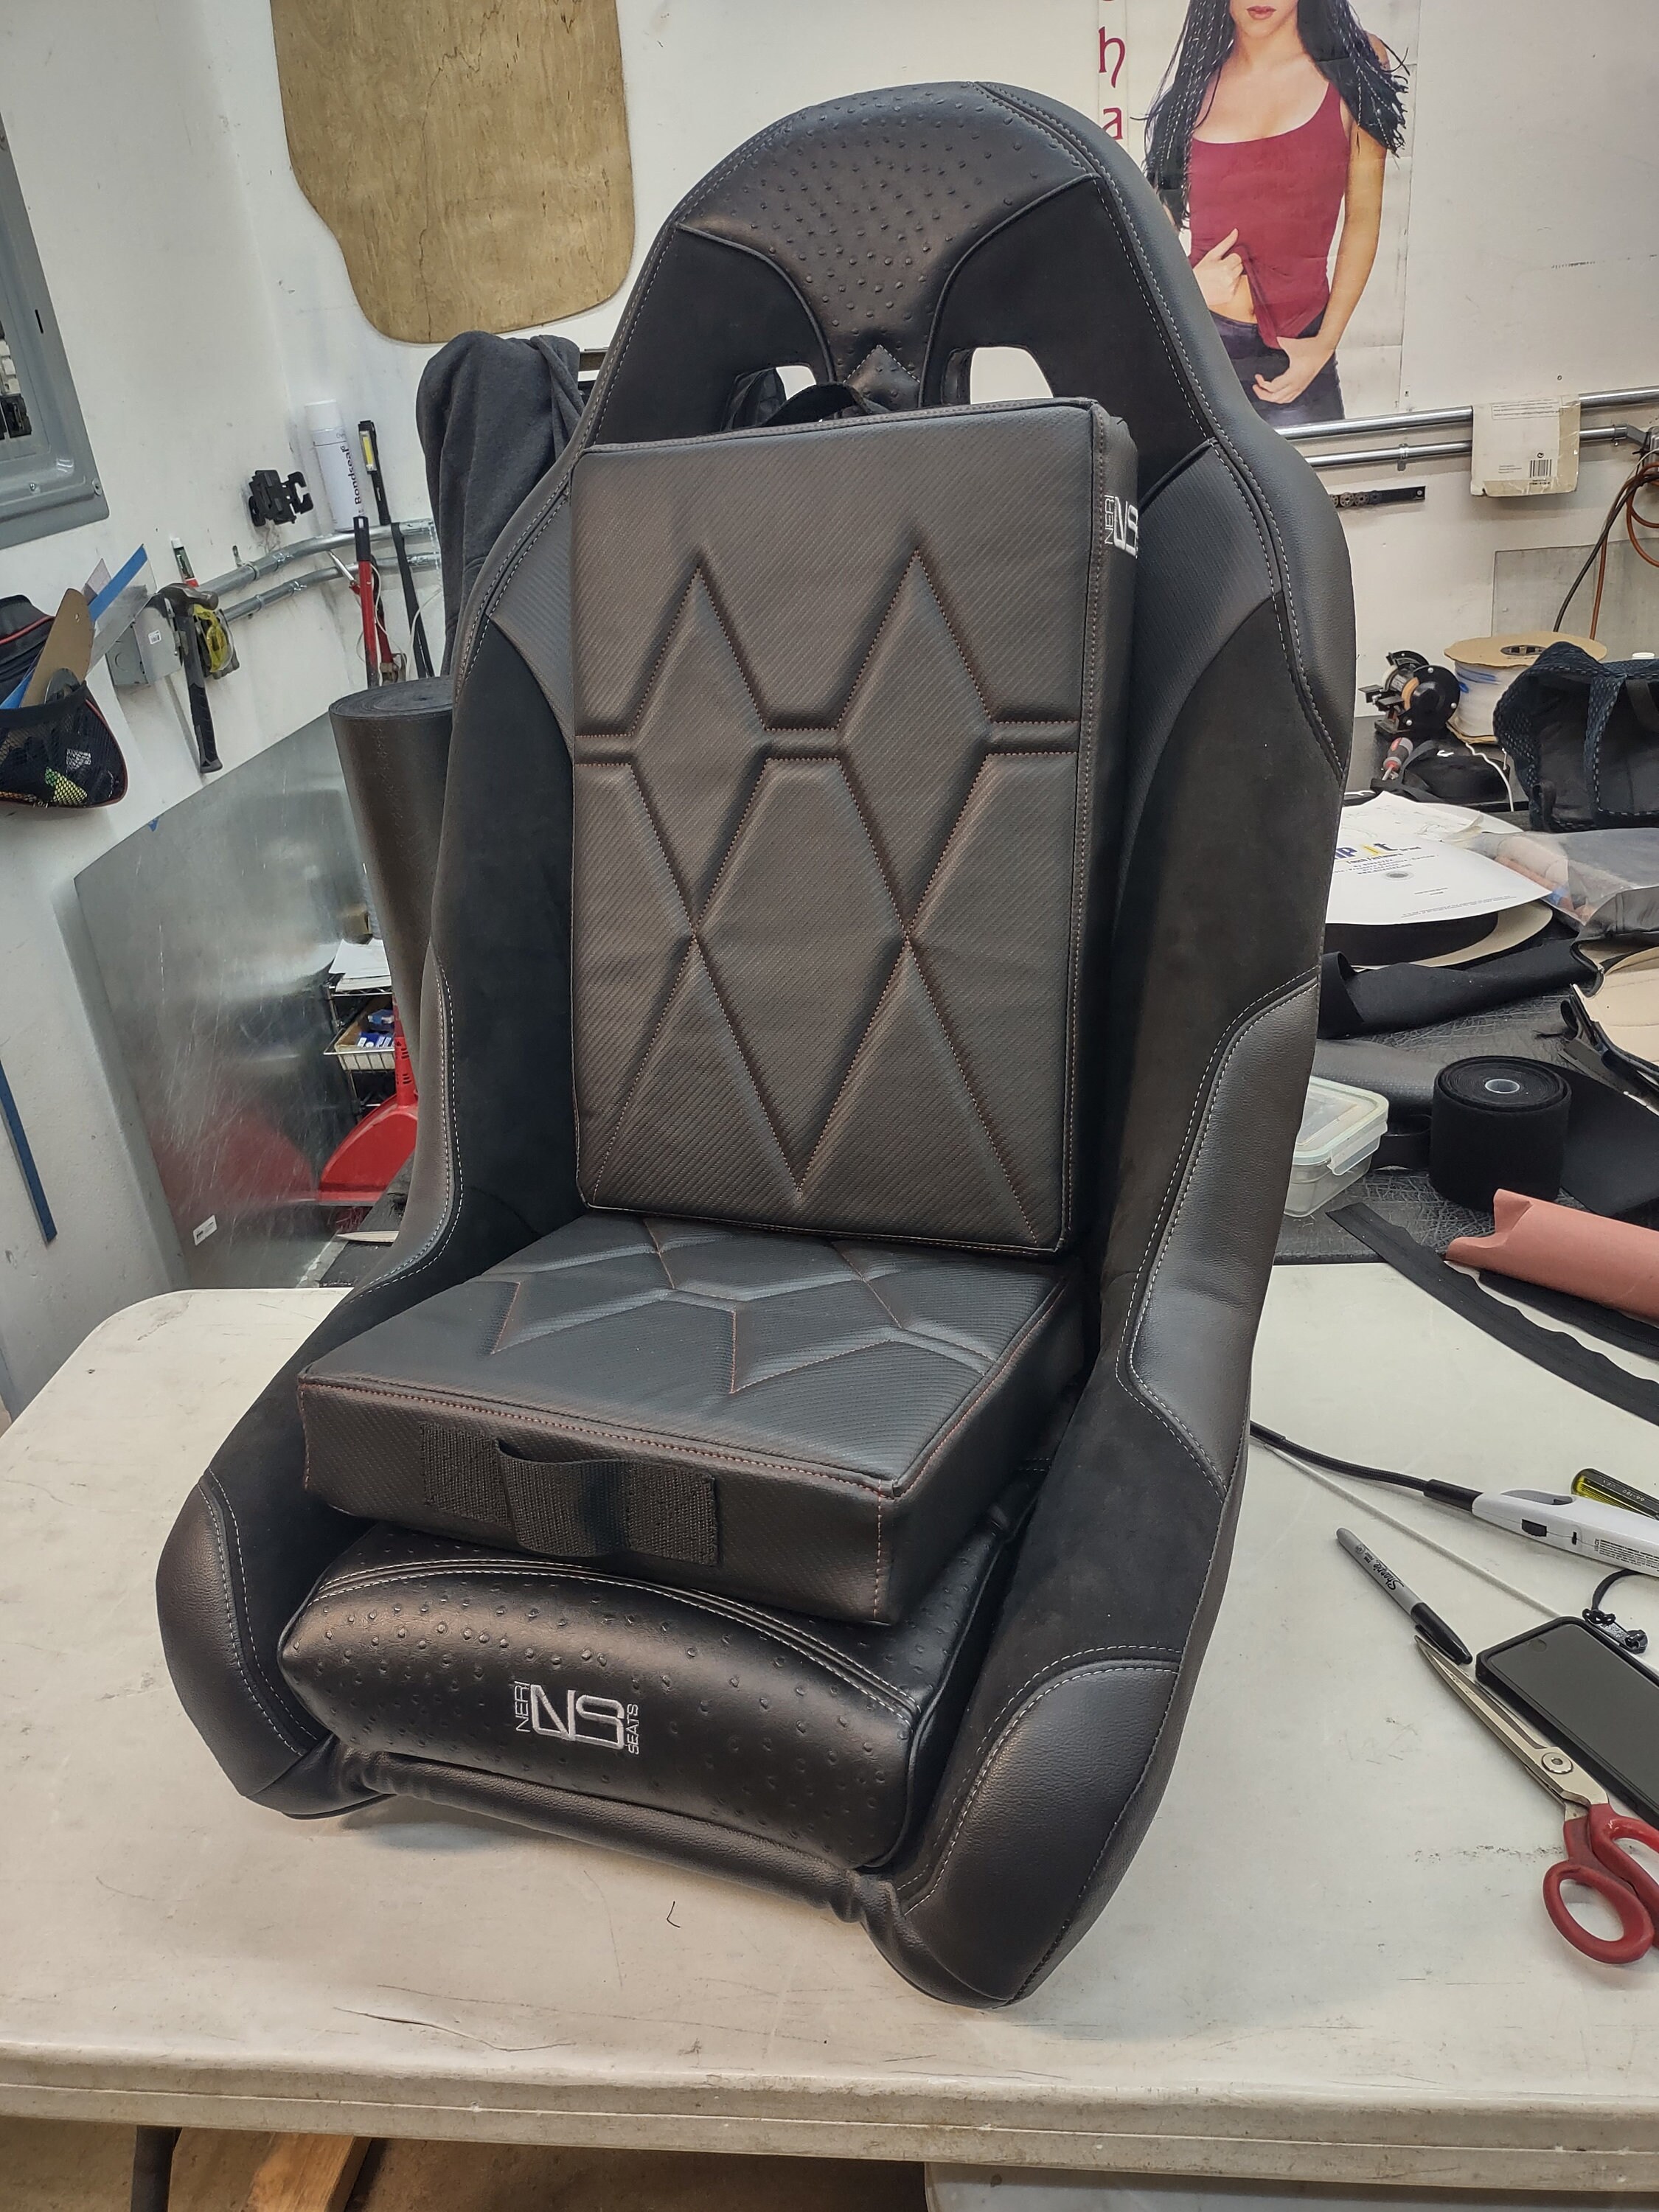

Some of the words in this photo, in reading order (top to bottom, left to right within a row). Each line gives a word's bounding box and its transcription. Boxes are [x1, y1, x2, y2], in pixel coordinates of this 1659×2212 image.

[1098, 0, 1125, 140] ha
[341, 445, 361, 504] Bondseal
[1104, 494, 1115, 544] NERI
[1335, 847, 1357, 860] IP
[1373, 1561, 1404, 1590] Sharpie
[514, 1680, 531, 1732] NERI
[529, 1684, 625, 1750] NS
[625, 1703, 639, 1755] SEATS
